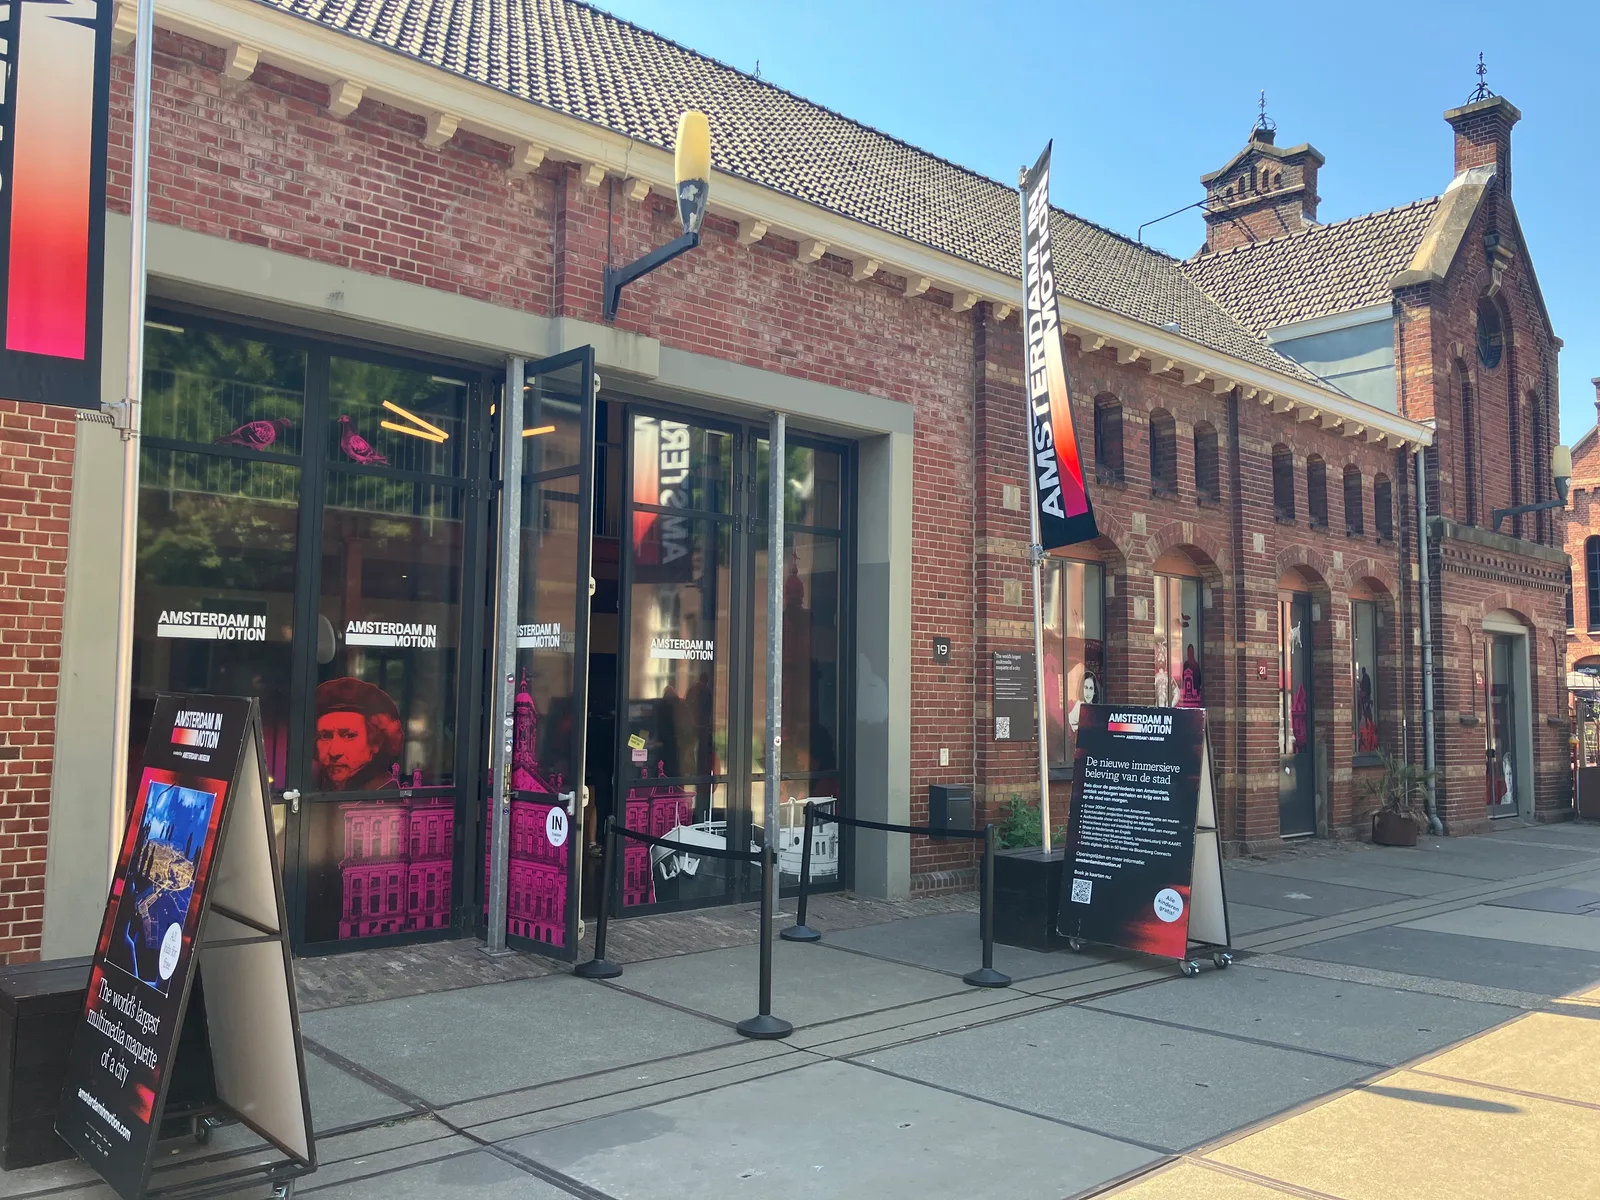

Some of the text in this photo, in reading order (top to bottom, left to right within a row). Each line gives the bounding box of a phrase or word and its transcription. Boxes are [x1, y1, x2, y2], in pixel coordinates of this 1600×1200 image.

[1038, 169, 1058, 332] MOTION
[1028, 187, 1065, 519] AMSTERDAM IN
[158, 610, 266, 628] AMSTERDAM IN
[217, 627, 266, 641] MOTION
[346, 620, 436, 636] AMSTERDAM IN
[553, 623, 560, 635] IN
[395, 636, 436, 648] MOTION
[535, 635, 560, 648] MOTION
[651, 638, 713, 650] AMSTERDAM IN
[683, 650, 713, 660] MOTION
[936, 644, 948, 655] 19
[1260, 666, 1266, 674] 21
[174, 710, 223, 730] AMSTERDAM IN
[1109, 713, 1172, 725] AMSTERDAM IN
[1140, 724, 1171, 734] MOTION
[195, 730, 220, 749] MOTION
[1086, 756, 1180, 773] De nieuwe immersieve
[1085, 768, 1171, 784] beleving van de stad
[1098, 790, 1118, 798] verborgen
[1109, 785, 1135, 793] geschiedenis
[1144, 788, 1169, 797] Amsterdam,
[552, 815, 562, 831] IN
[1076, 850, 1105, 860] Openingstijden
[1158, 898, 1179, 912] kinderen
[1159, 906, 1175, 916] gratis!
[98, 977, 161, 1035] The world's largest
[87, 1009, 158, 1070] multimedia maquette
[101, 1047, 129, 1089] of a city
[78, 1087, 131, 1142] amsterdaminmotion.com
